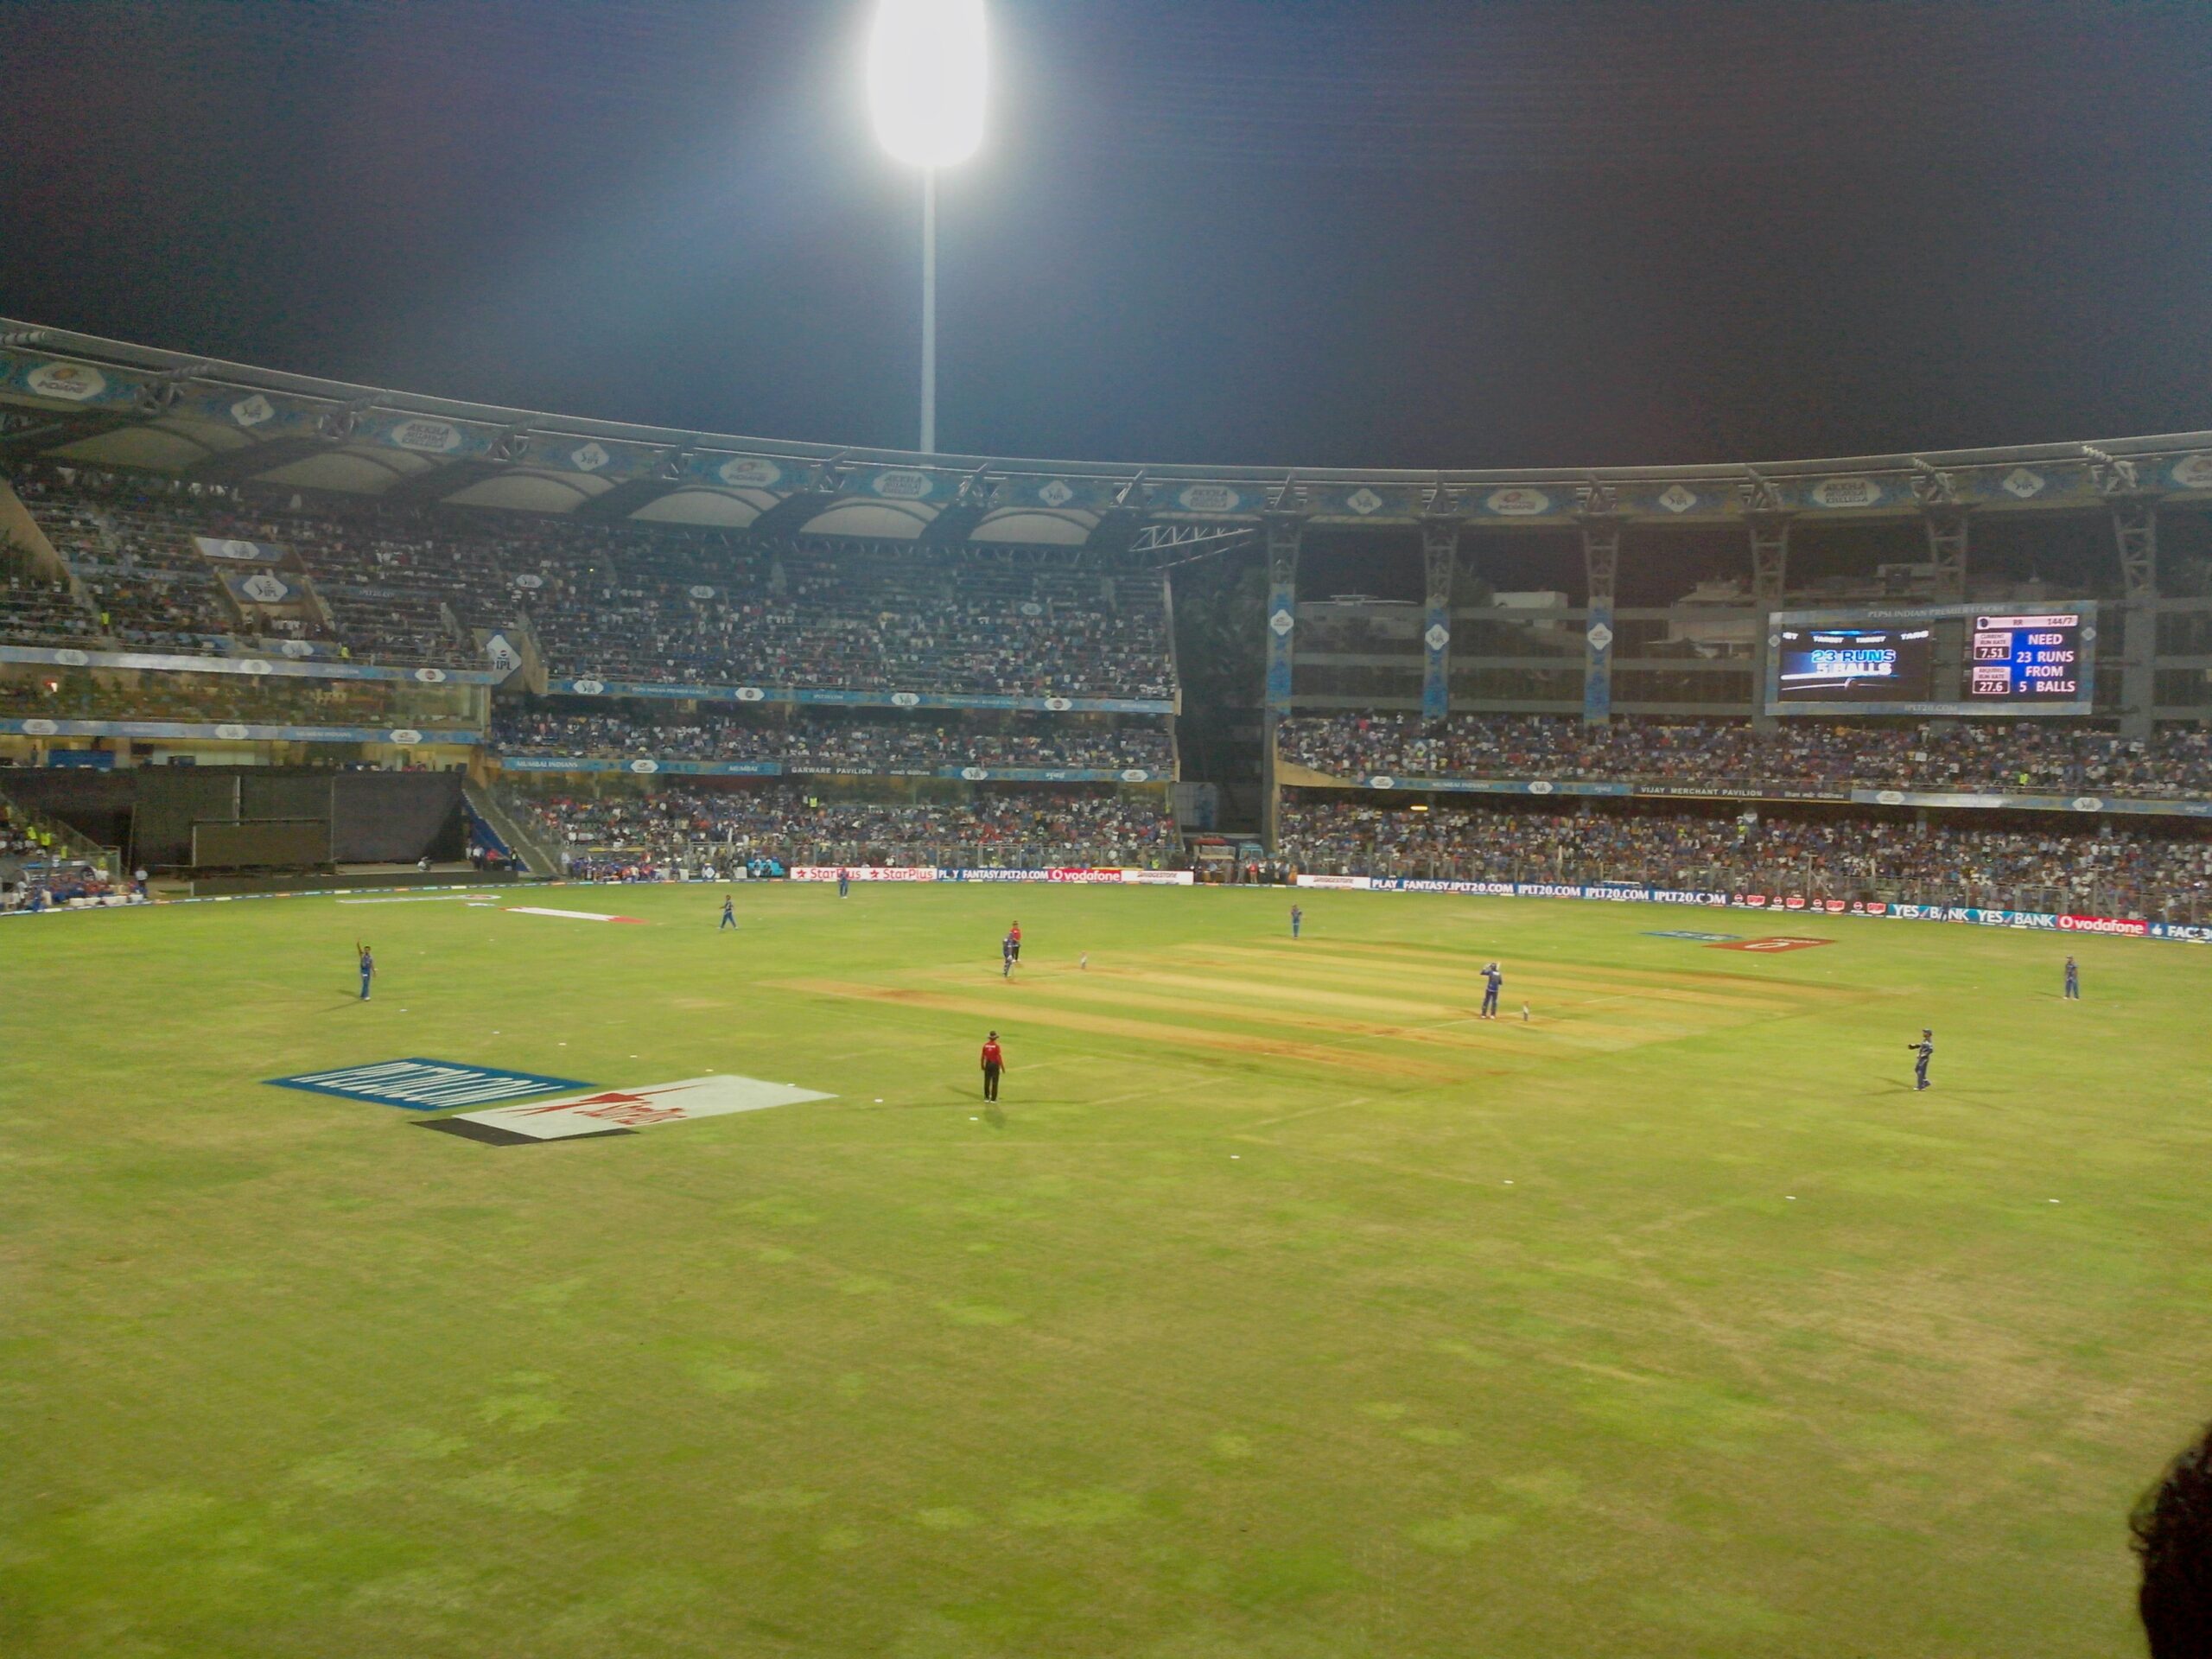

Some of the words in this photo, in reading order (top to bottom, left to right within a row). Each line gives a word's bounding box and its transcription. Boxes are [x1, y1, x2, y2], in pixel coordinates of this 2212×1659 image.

[1894, 609, 1926, 618] INDIAN
[1929, 607, 1968, 616] PREMIER
[2047, 617, 2072, 626] 144/7
[2028, 633, 2063, 645] NEED
[1811, 649, 1838, 663] 23
[1841, 649, 1897, 663] RUNS
[1981, 648, 2004, 658] 7.51
[2016, 651, 2032, 664] 23
[2037, 651, 2075, 663] RUNS
[496, 661, 512, 671] IPL
[1833, 663, 1892, 675] BALLS
[2025, 665, 2063, 677] FROM
[1980, 682, 2003, 692] 27.6
[2019, 681, 2027, 692] 5
[2036, 681, 2075, 692] BALLS
[1722, 788, 1763, 797] PAVILION
[810, 868, 861, 880] StarPus
[883, 868, 933, 880] StarPlus
[938, 869, 960, 880] PLY
[963, 869, 1049, 880] FANTASY.IPLT20.COM
[1064, 869, 1121, 882] vodafone
[1372, 879, 1397, 889] PLAY
[1403, 879, 1515, 893] FANTASY.IPLT20.COM
[1518, 884, 1580, 897] IPLT20.COM
[1586, 887, 1649, 900] IPLT20.COM
[1892, 904, 1919, 918] YES
[1976, 910, 2003, 924] YES
[2014, 912, 2056, 927] BANK
[2075, 918, 2144, 934] vodafone
